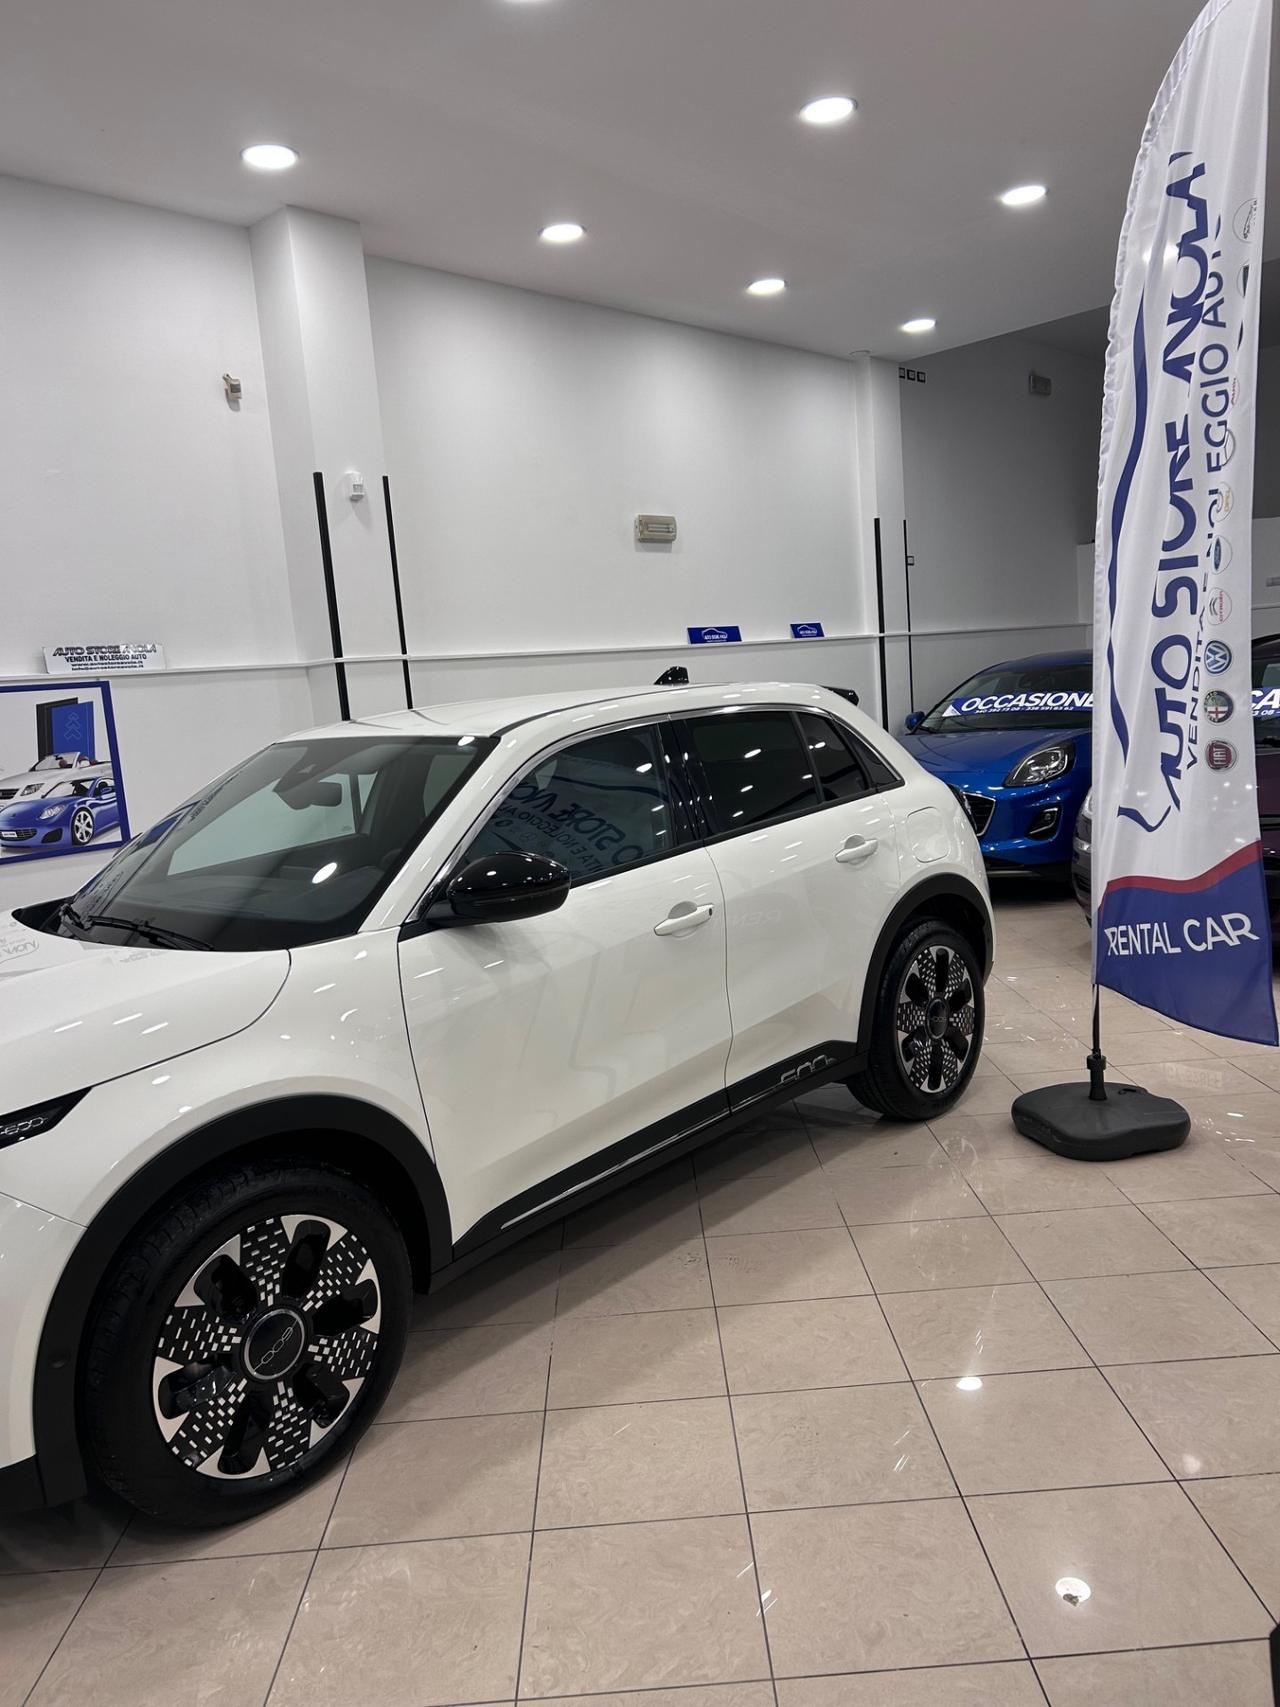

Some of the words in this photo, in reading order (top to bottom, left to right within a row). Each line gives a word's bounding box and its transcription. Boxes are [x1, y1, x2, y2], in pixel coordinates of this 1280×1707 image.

[53, 647, 85, 656] AUTO
[1213, 746, 1227, 765] FIAT
[1104, 921, 1182, 957] RENTAL
[1183, 912, 1260, 952] CAR
